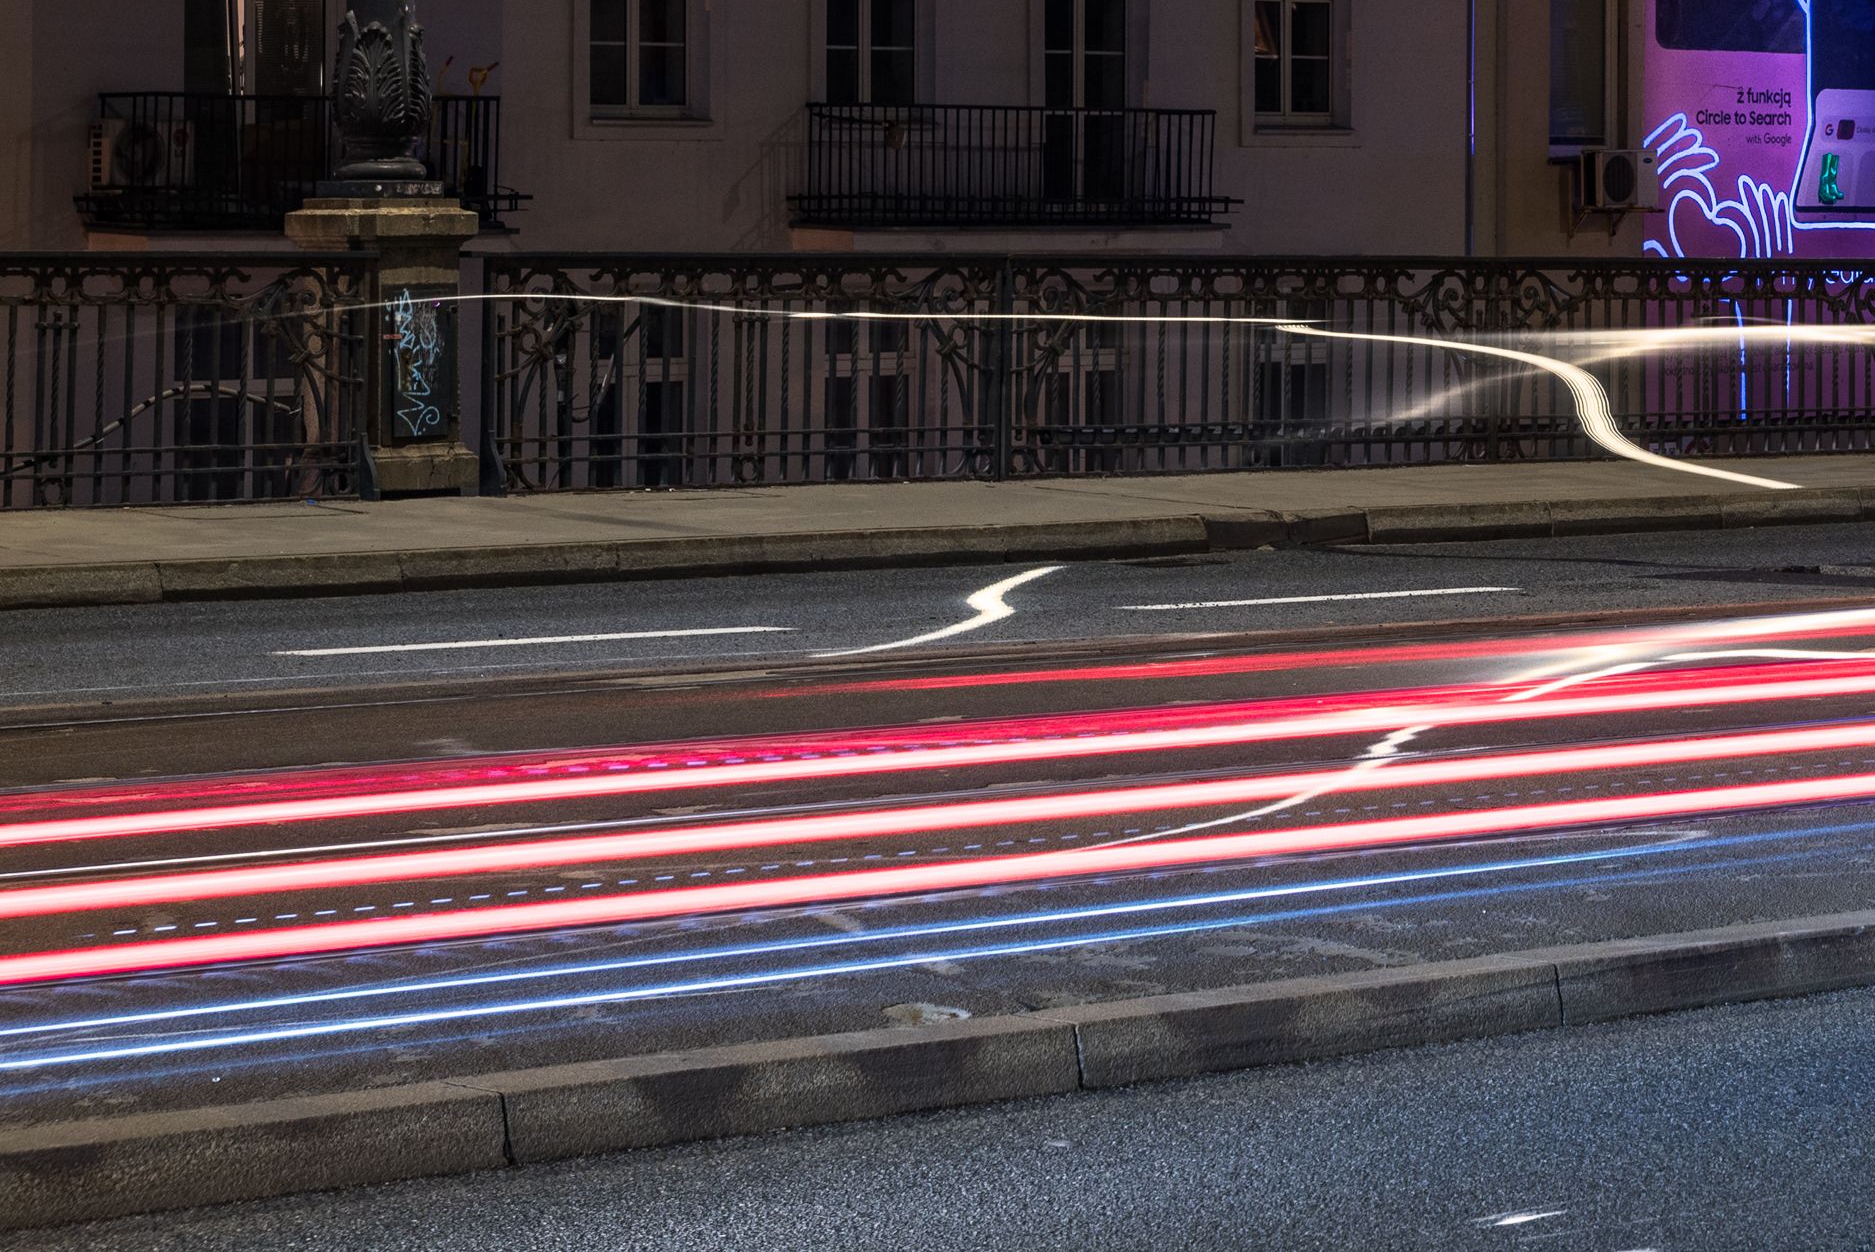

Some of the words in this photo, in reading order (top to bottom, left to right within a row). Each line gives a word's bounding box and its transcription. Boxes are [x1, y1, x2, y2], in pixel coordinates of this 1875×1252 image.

[1747, 87, 1792, 109] funkcją
[1696, 109, 1731, 125] Circle
[1734, 110, 1747, 125] to
[1749, 110, 1792, 125] Search
[1746, 134, 1761, 144] with
[1763, 132, 1792, 147] Google
